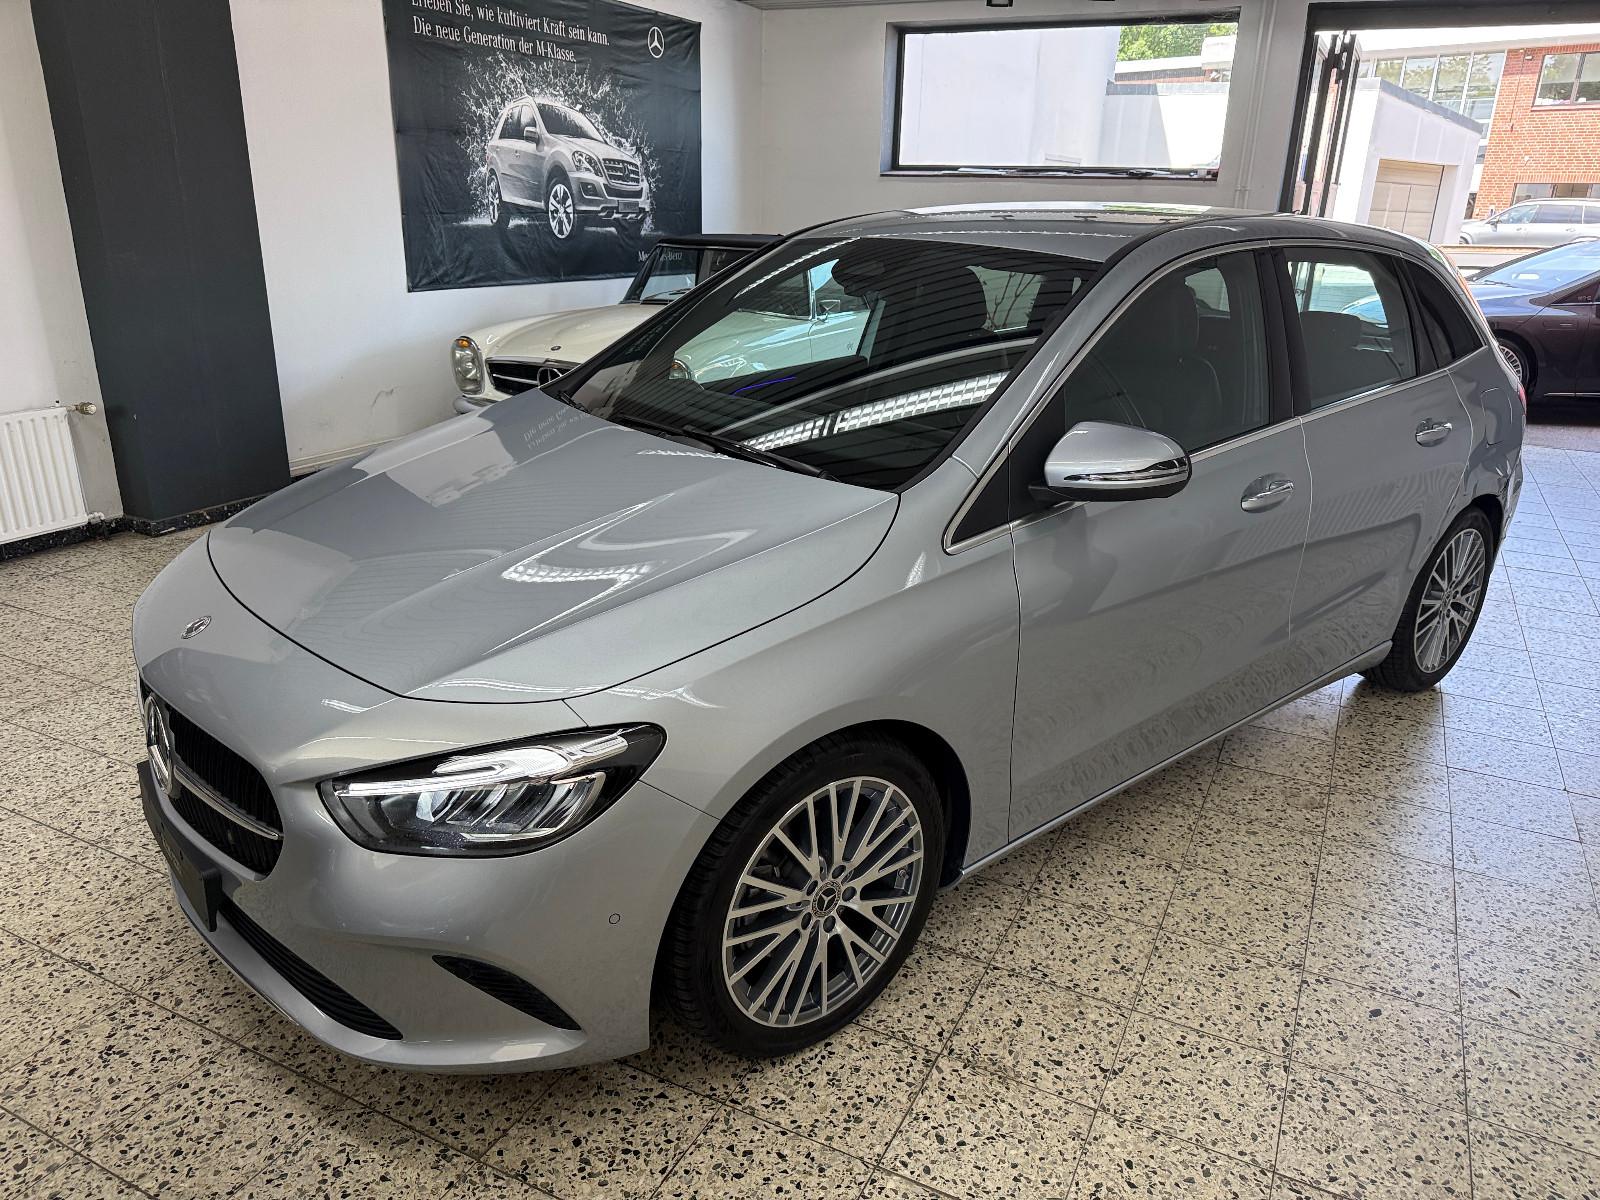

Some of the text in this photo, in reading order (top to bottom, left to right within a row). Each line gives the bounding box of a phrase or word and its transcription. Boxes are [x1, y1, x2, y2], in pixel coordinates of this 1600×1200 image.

[413, 16, 577, 62] Die neue Generation der M-Klasse.
[455, 0, 474, 20] Sie,
[477, 5, 494, 21] wie
[497, 7, 541, 31] kultiviert
[543, 17, 566, 37] Kraft
[568, 25, 585, 41] sein
[587, 26, 610, 46] kann.
